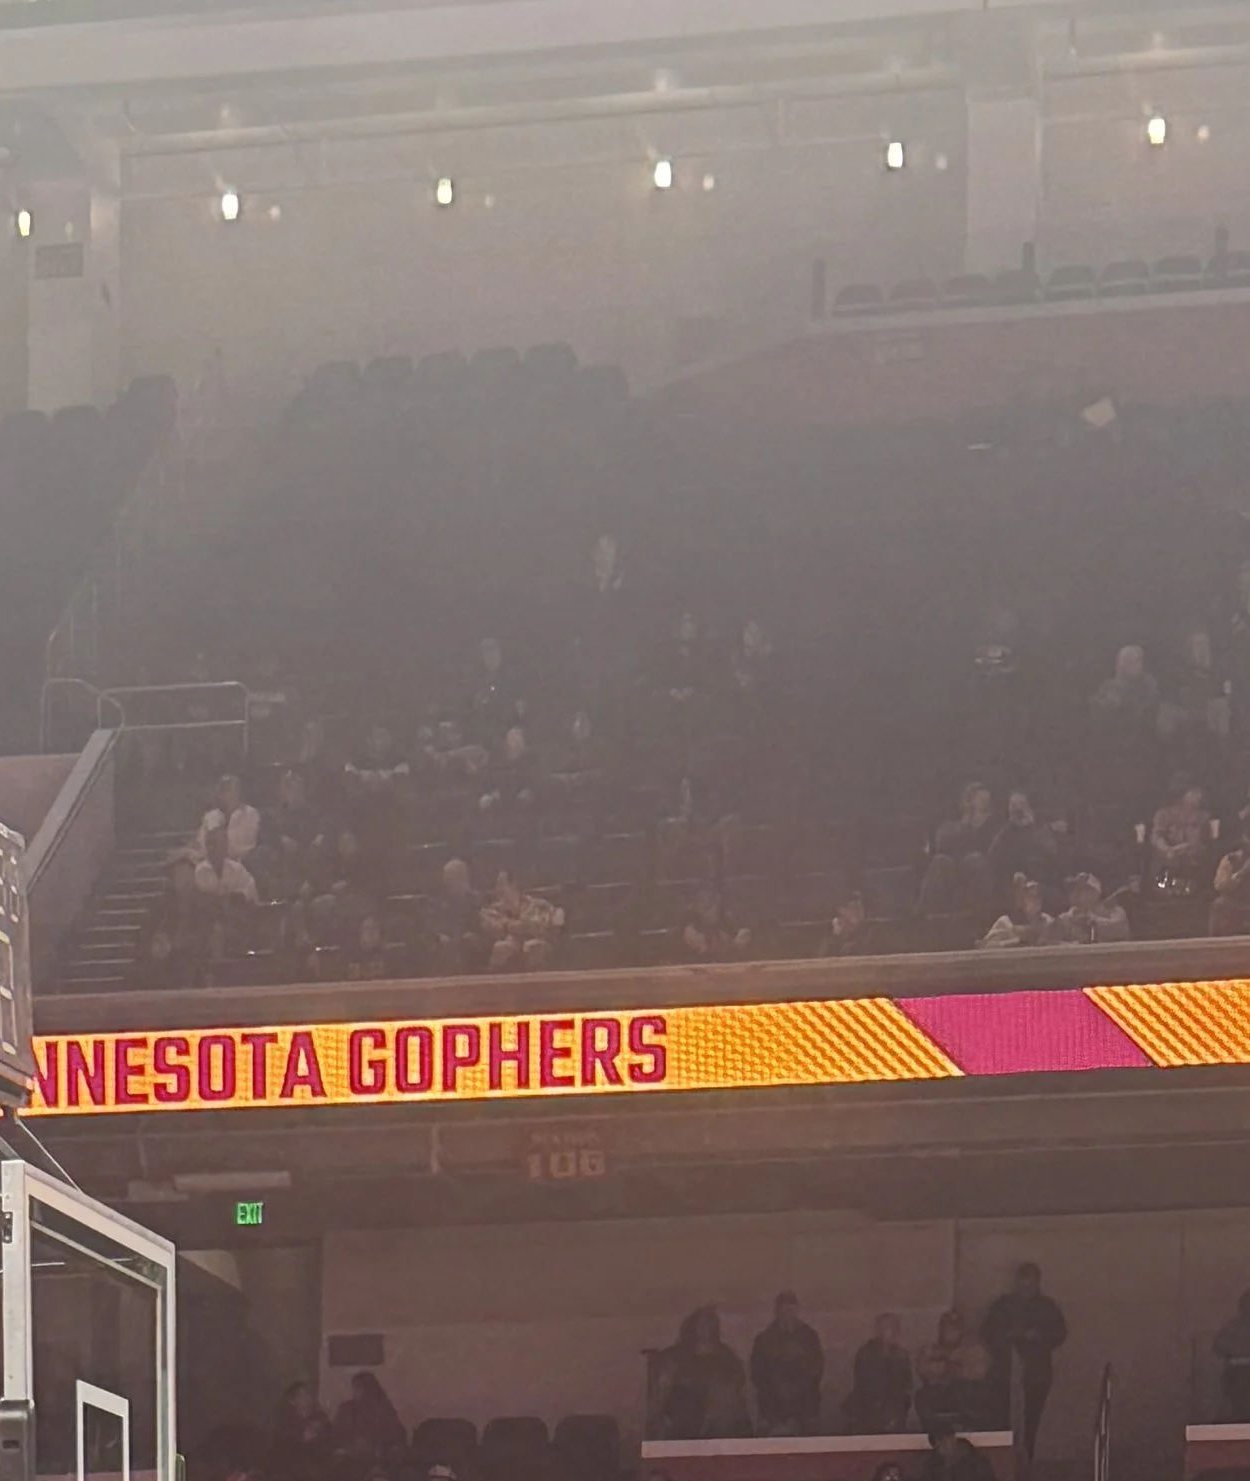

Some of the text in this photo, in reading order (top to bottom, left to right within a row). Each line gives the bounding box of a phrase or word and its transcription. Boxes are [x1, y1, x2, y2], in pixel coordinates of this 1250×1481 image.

[32, 1015, 667, 1109] NNESOTA GOPHERS
[237, 1202, 264, 1225] EXIT
